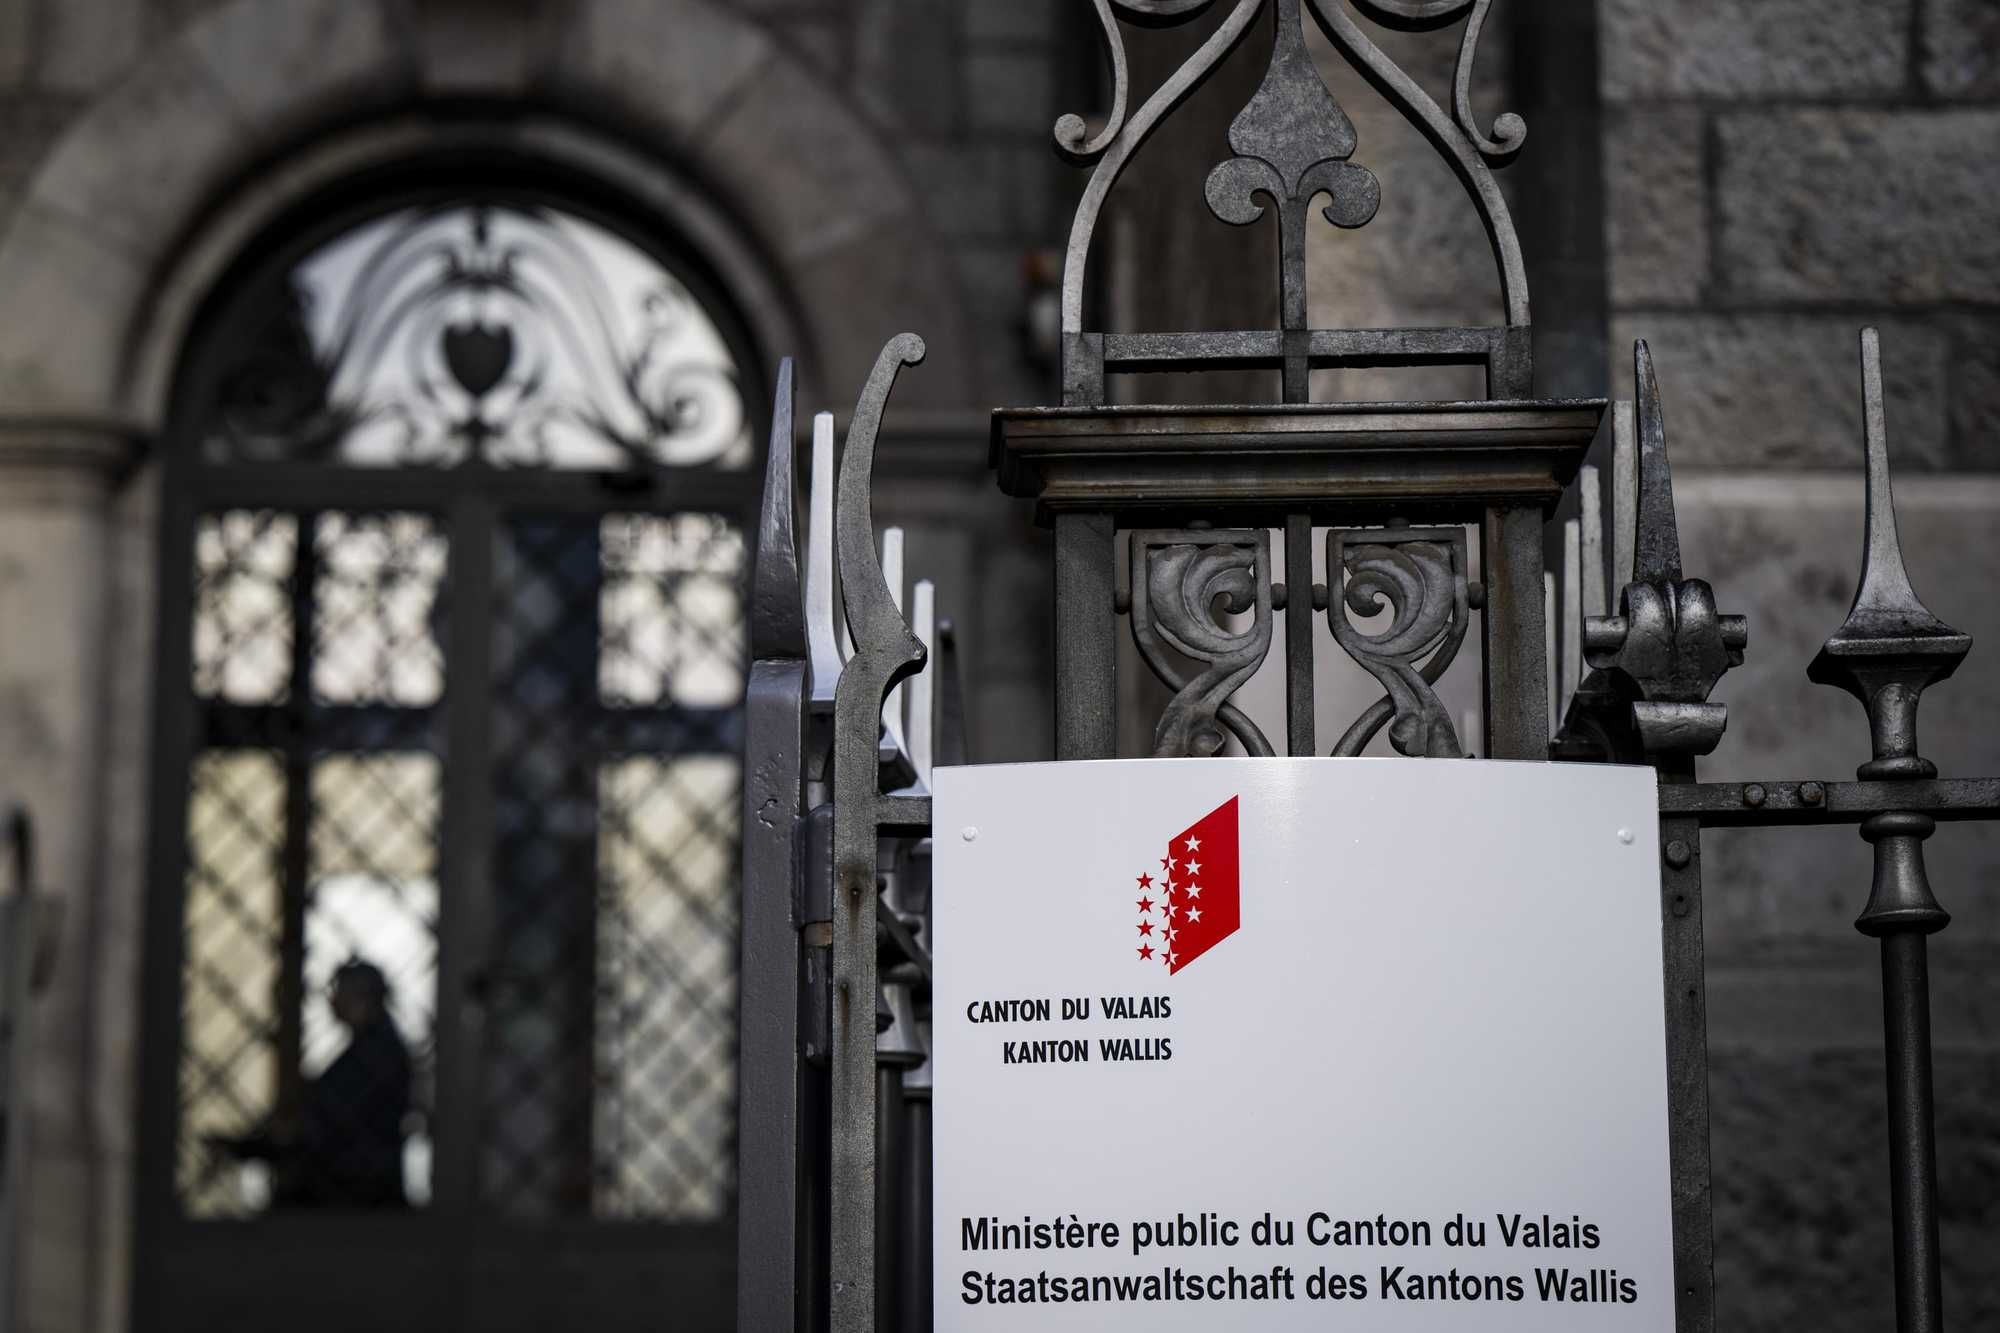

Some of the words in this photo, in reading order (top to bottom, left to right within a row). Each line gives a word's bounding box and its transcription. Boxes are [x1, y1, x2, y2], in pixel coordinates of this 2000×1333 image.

[967, 999, 1050, 1023] CANTON
[1062, 998, 1089, 1020] DU
[1101, 996, 1171, 1019] VALAIS
[1004, 1040, 1088, 1064] KANTON
[1099, 1038, 1172, 1061] WALLIS
[962, 1215, 1119, 1250] Ministère
[1133, 1213, 1239, 1255] public
[1251, 1213, 1293, 1246] du
[1307, 1212, 1430, 1246] Canton
[1444, 1213, 1485, 1247] du
[1496, 1214, 1600, 1249] Valais
[961, 1266, 1295, 1304] Staatsanwaltschaft
[1306, 1266, 1367, 1300] des
[1381, 1266, 1524, 1301] Kantons
[1534, 1268, 1637, 1303] Wallis
